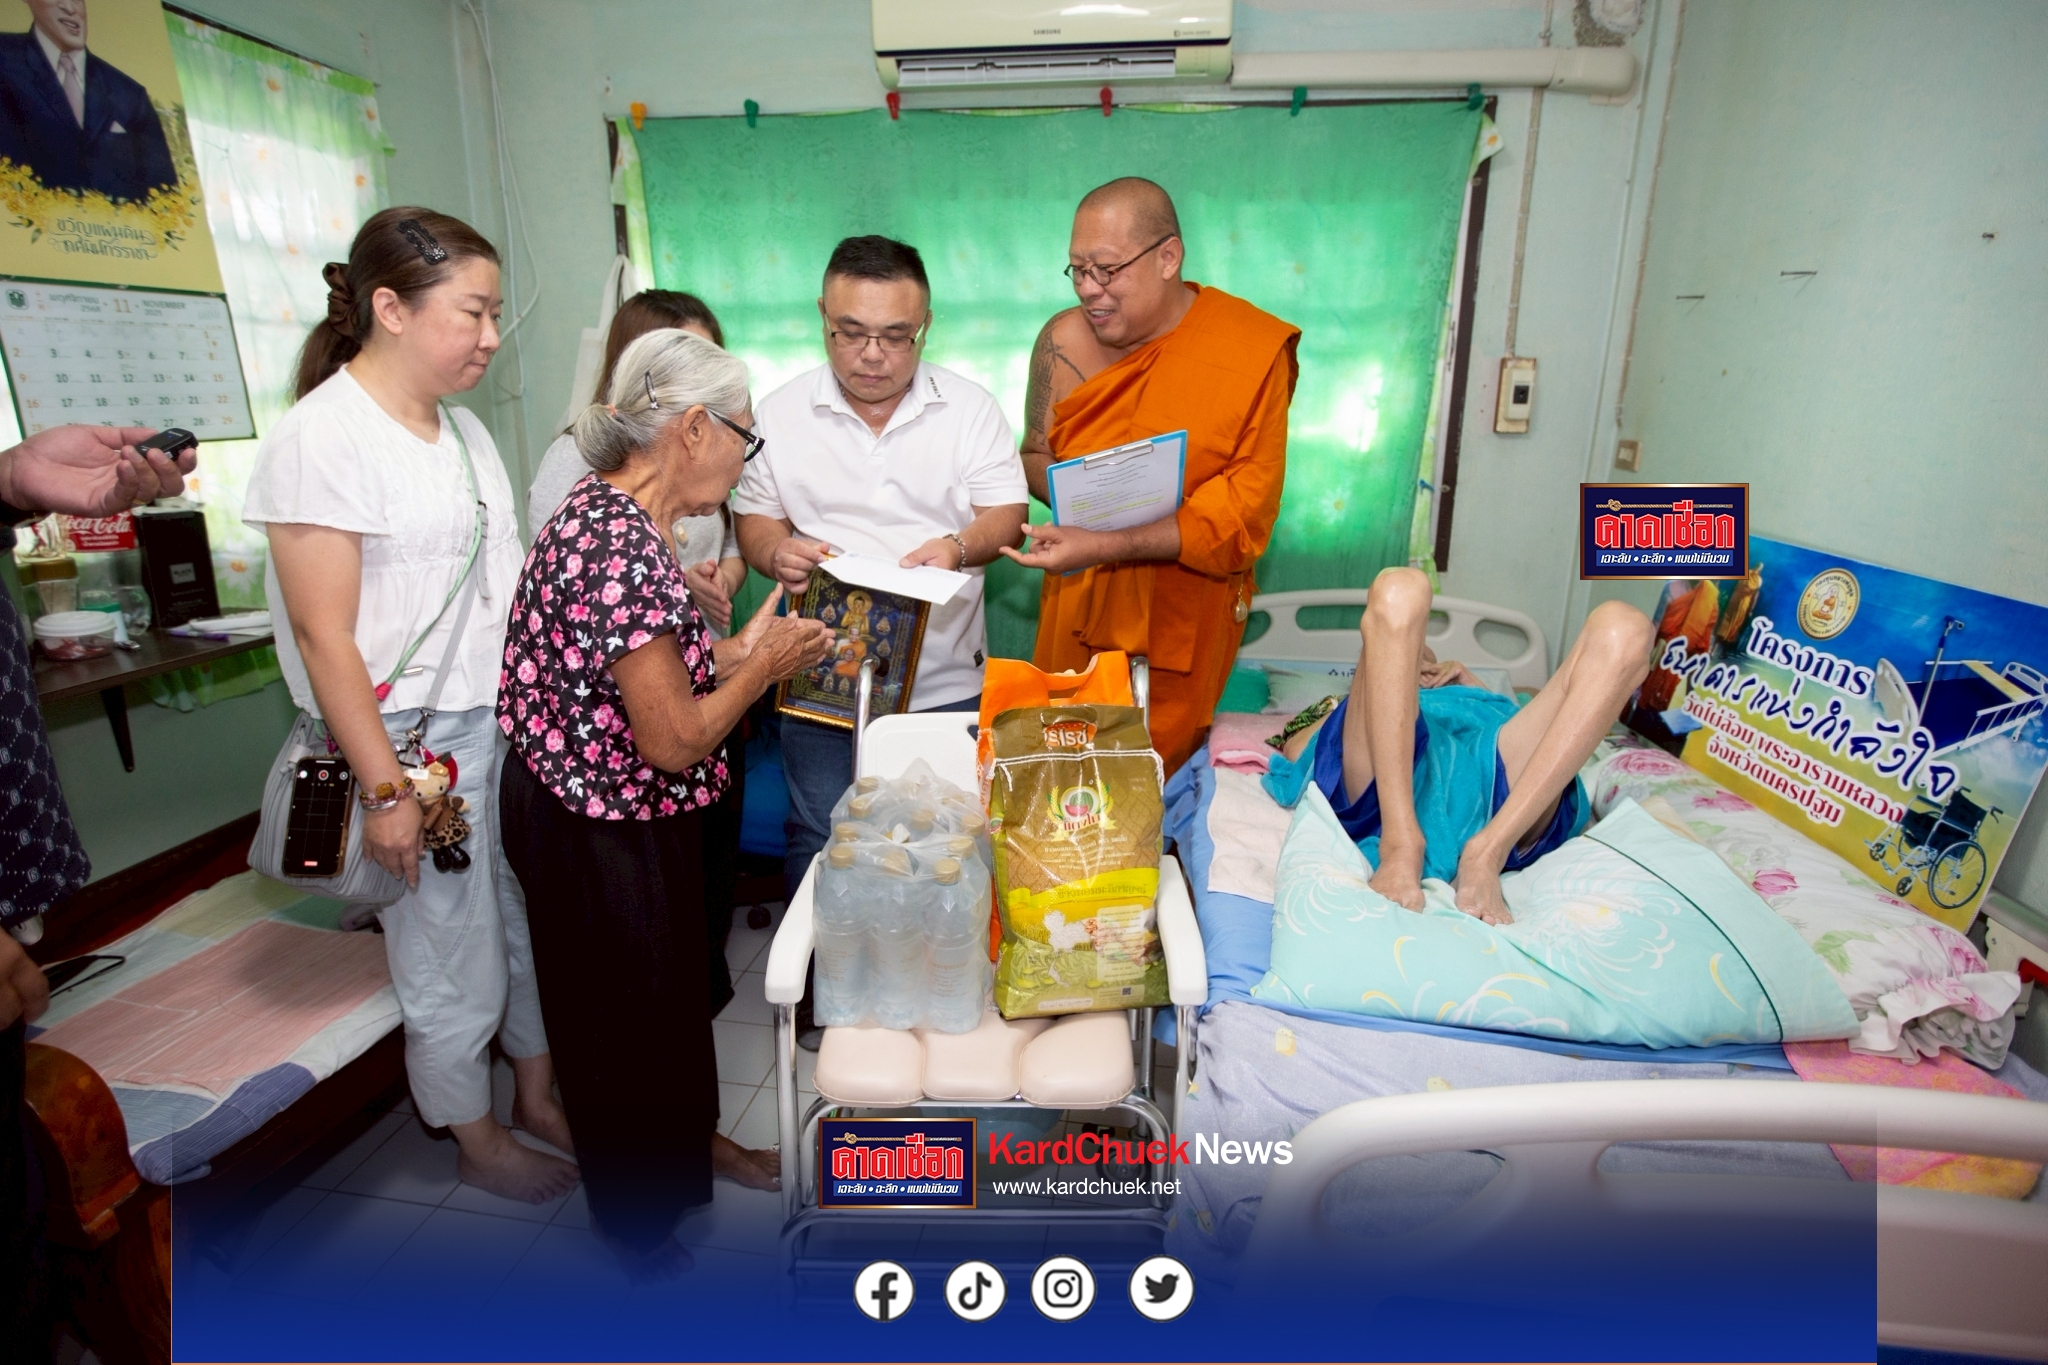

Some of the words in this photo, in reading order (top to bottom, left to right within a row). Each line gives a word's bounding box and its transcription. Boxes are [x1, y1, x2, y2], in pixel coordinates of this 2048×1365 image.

[114, 298, 132, 313] 11
[142, 300, 186, 309] NOVEMBER
[50, 348, 58, 358] 3
[85, 349, 92, 358] 4
[117, 350, 124, 359] 5
[148, 351, 155, 360] 6
[178, 351, 185, 360] 7
[56, 373, 69, 383] 10
[90, 374, 102, 383] 11
[122, 374, 134, 383] 12
[153, 373, 165, 382] 13
[184, 374, 195, 382] 14
[61, 398, 73, 408] 17
[95, 397, 108, 407] 18
[128, 397, 139, 406] 19
[158, 396, 171, 405] 20
[188, 396, 199, 405] 21
[164, 418, 174, 427] 27
[193, 417, 205, 426] 28
[1749, 620, 1870, 695] โครงการ
[1662, 638, 1956, 797] ธนาคารแห่งกำลังใจ
[1683, 694, 1755, 745] วัดไผ่ล้อม
[1757, 736, 1904, 824] พระอารามหลวง
[1708, 735, 1842, 824] จังหวัดนครปฐม
